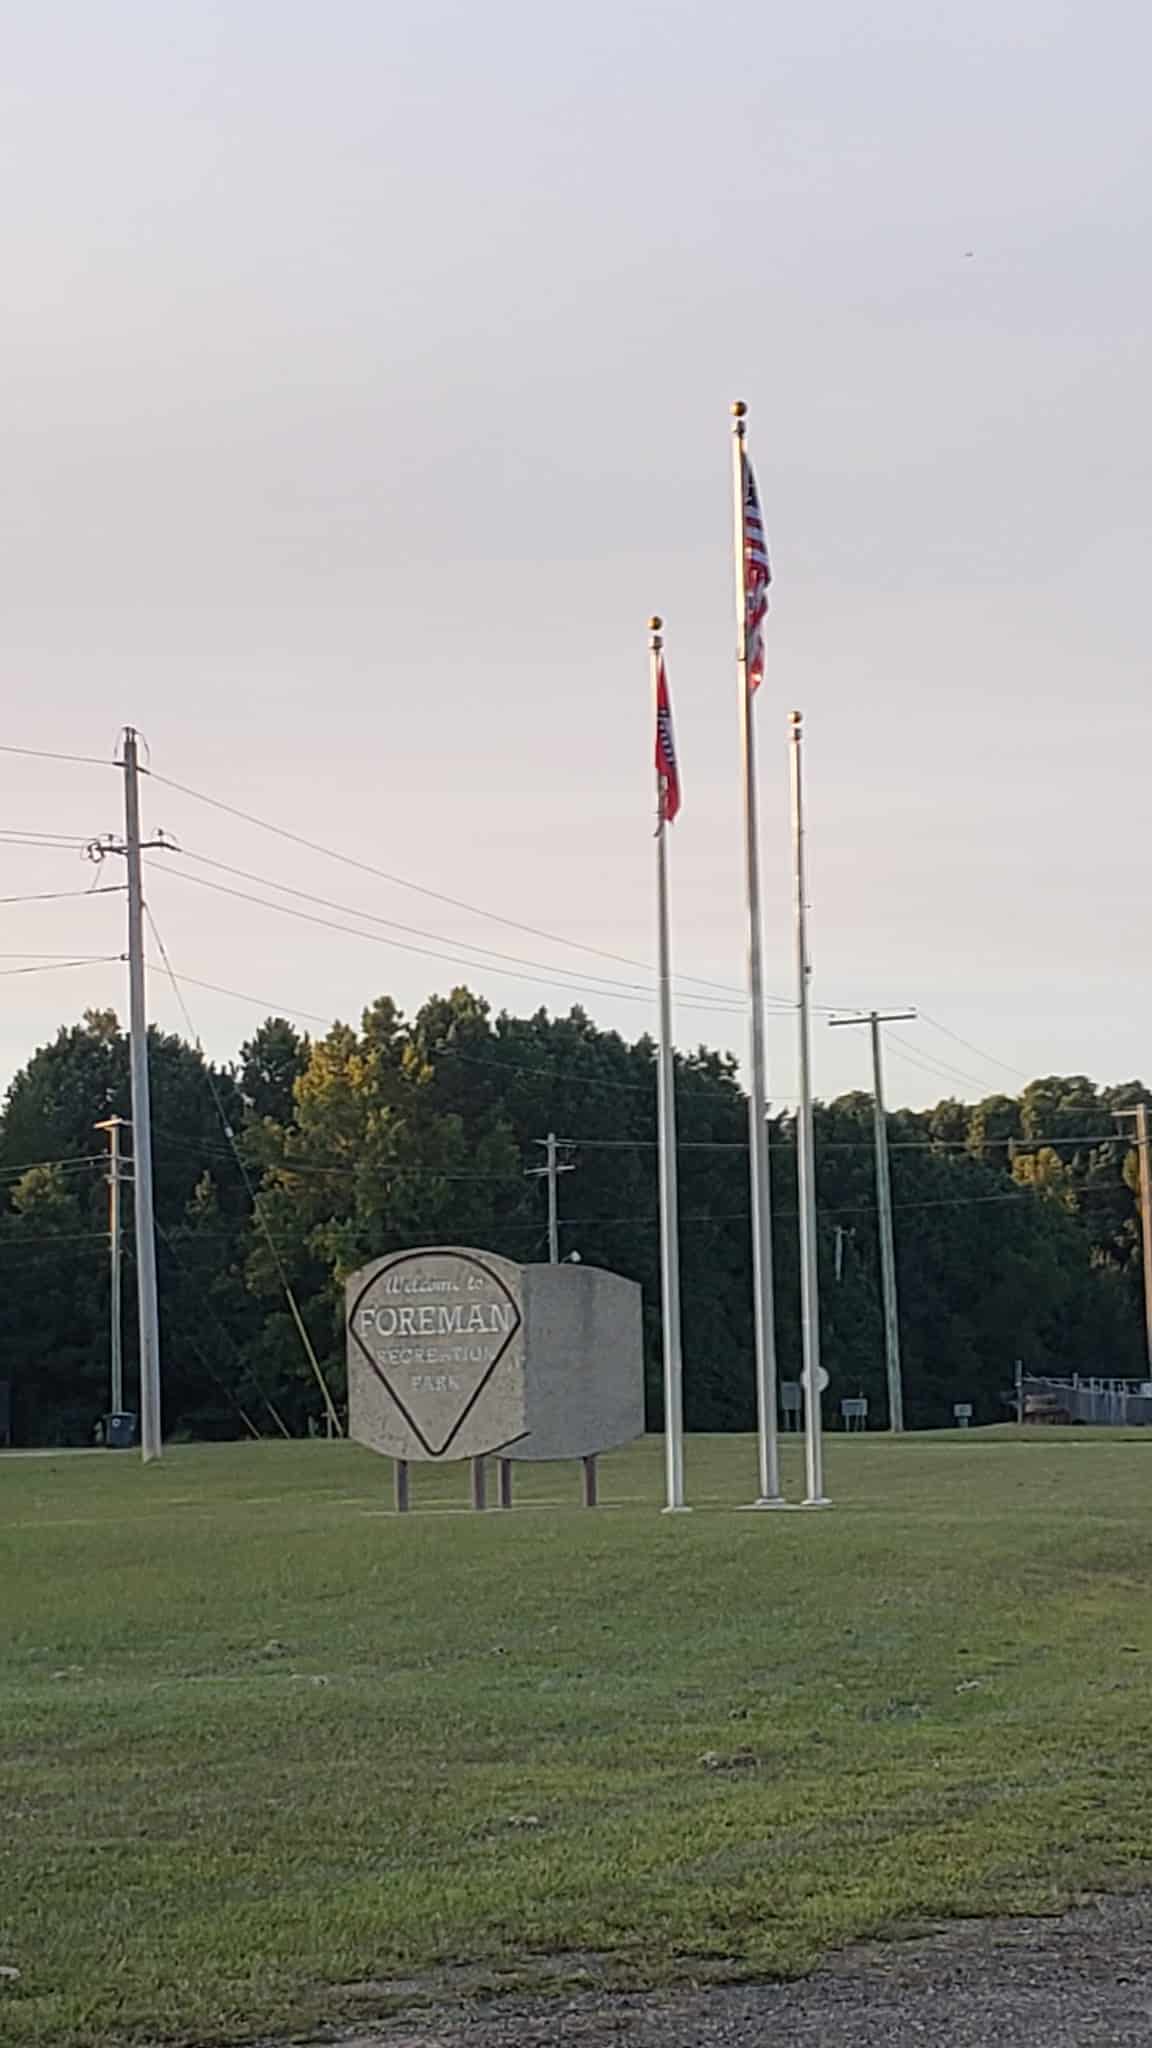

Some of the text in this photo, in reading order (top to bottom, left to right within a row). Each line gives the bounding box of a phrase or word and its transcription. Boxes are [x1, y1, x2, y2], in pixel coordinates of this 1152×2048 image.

[384, 1275, 484, 1294] Welcome to
[359, 1303, 513, 1337] FOREMAN
[411, 1375, 459, 1392] PARK
